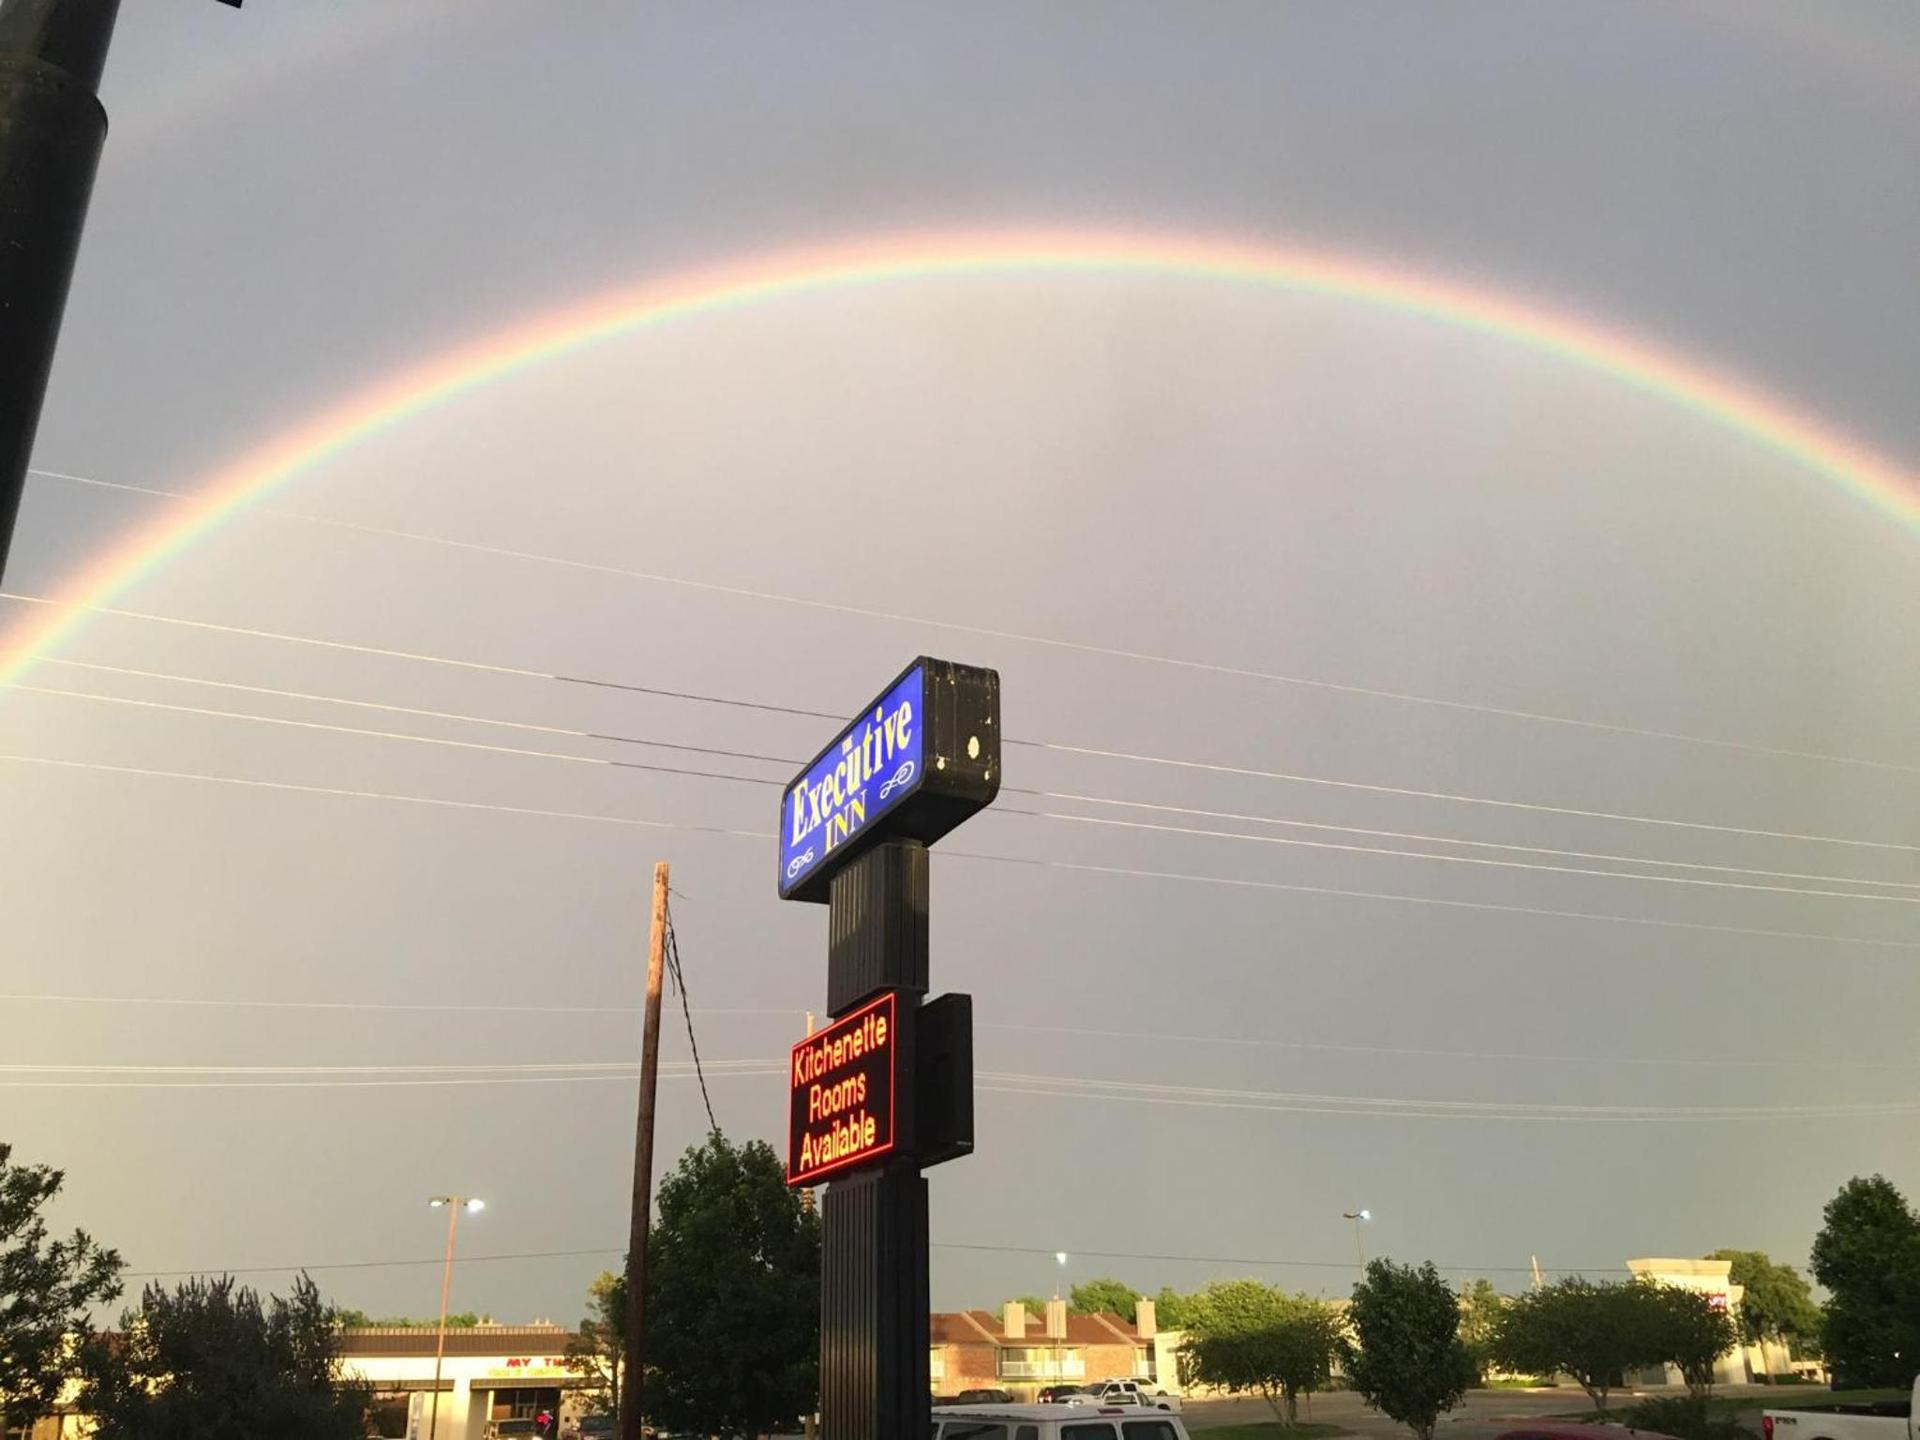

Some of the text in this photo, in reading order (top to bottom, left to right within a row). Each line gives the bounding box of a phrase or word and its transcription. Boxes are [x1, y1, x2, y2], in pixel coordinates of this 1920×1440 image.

[790, 701, 912, 847] Executive
[824, 789, 868, 856] INN
[793, 1013, 887, 1087] Kitchenette
[809, 1072, 866, 1123] Rooms
[799, 1109, 876, 1172] Available
